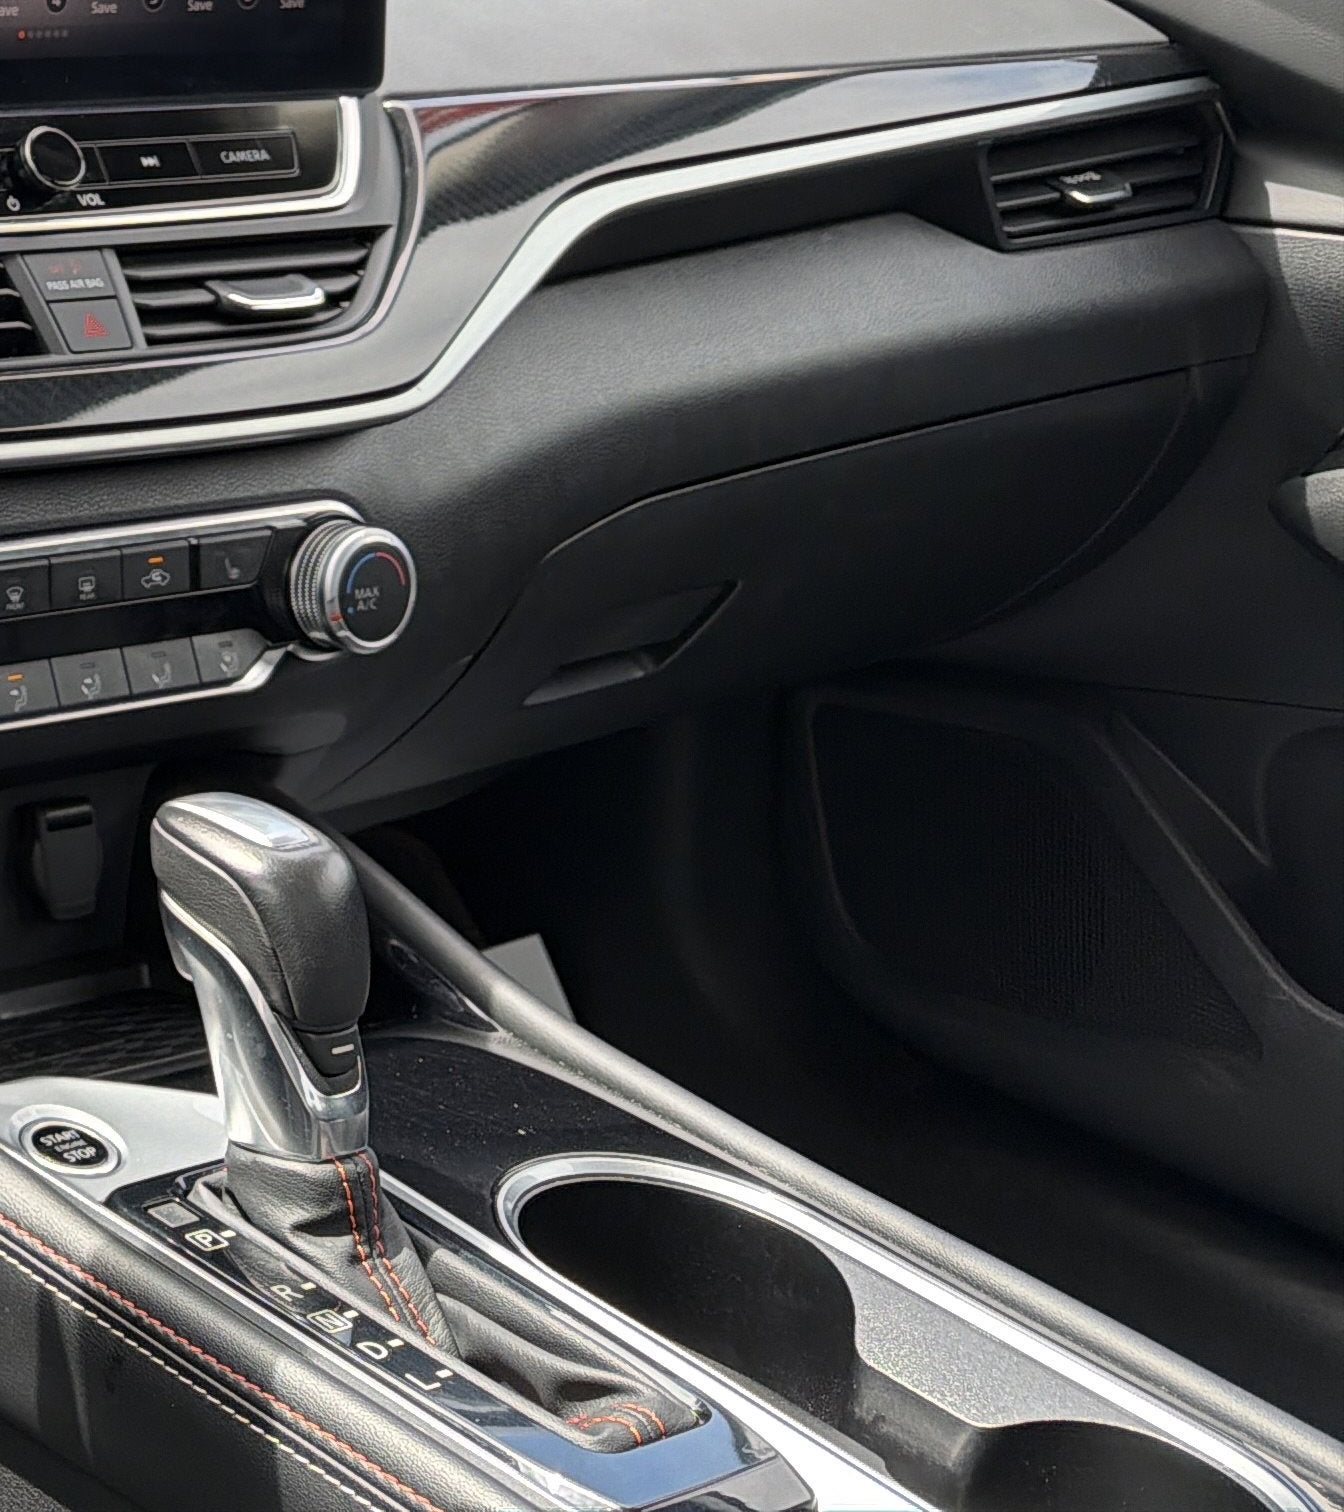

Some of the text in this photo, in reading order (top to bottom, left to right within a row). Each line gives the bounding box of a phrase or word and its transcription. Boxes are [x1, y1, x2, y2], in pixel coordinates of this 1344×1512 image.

[91, 1, 118, 15] Save
[187, 0, 213, 13] Save
[220, 148, 270, 165] CAMERA
[76, 193, 106, 207] VOL
[354, 586, 380, 600] MAX
[356, 598, 377, 611] A/C
[39, 1129, 81, 1147] START
[62, 1145, 97, 1163] STOP
[269, 1284, 305, 1303] R
[356, 1341, 389, 1360] D
[405, 1372, 441, 1391] L
